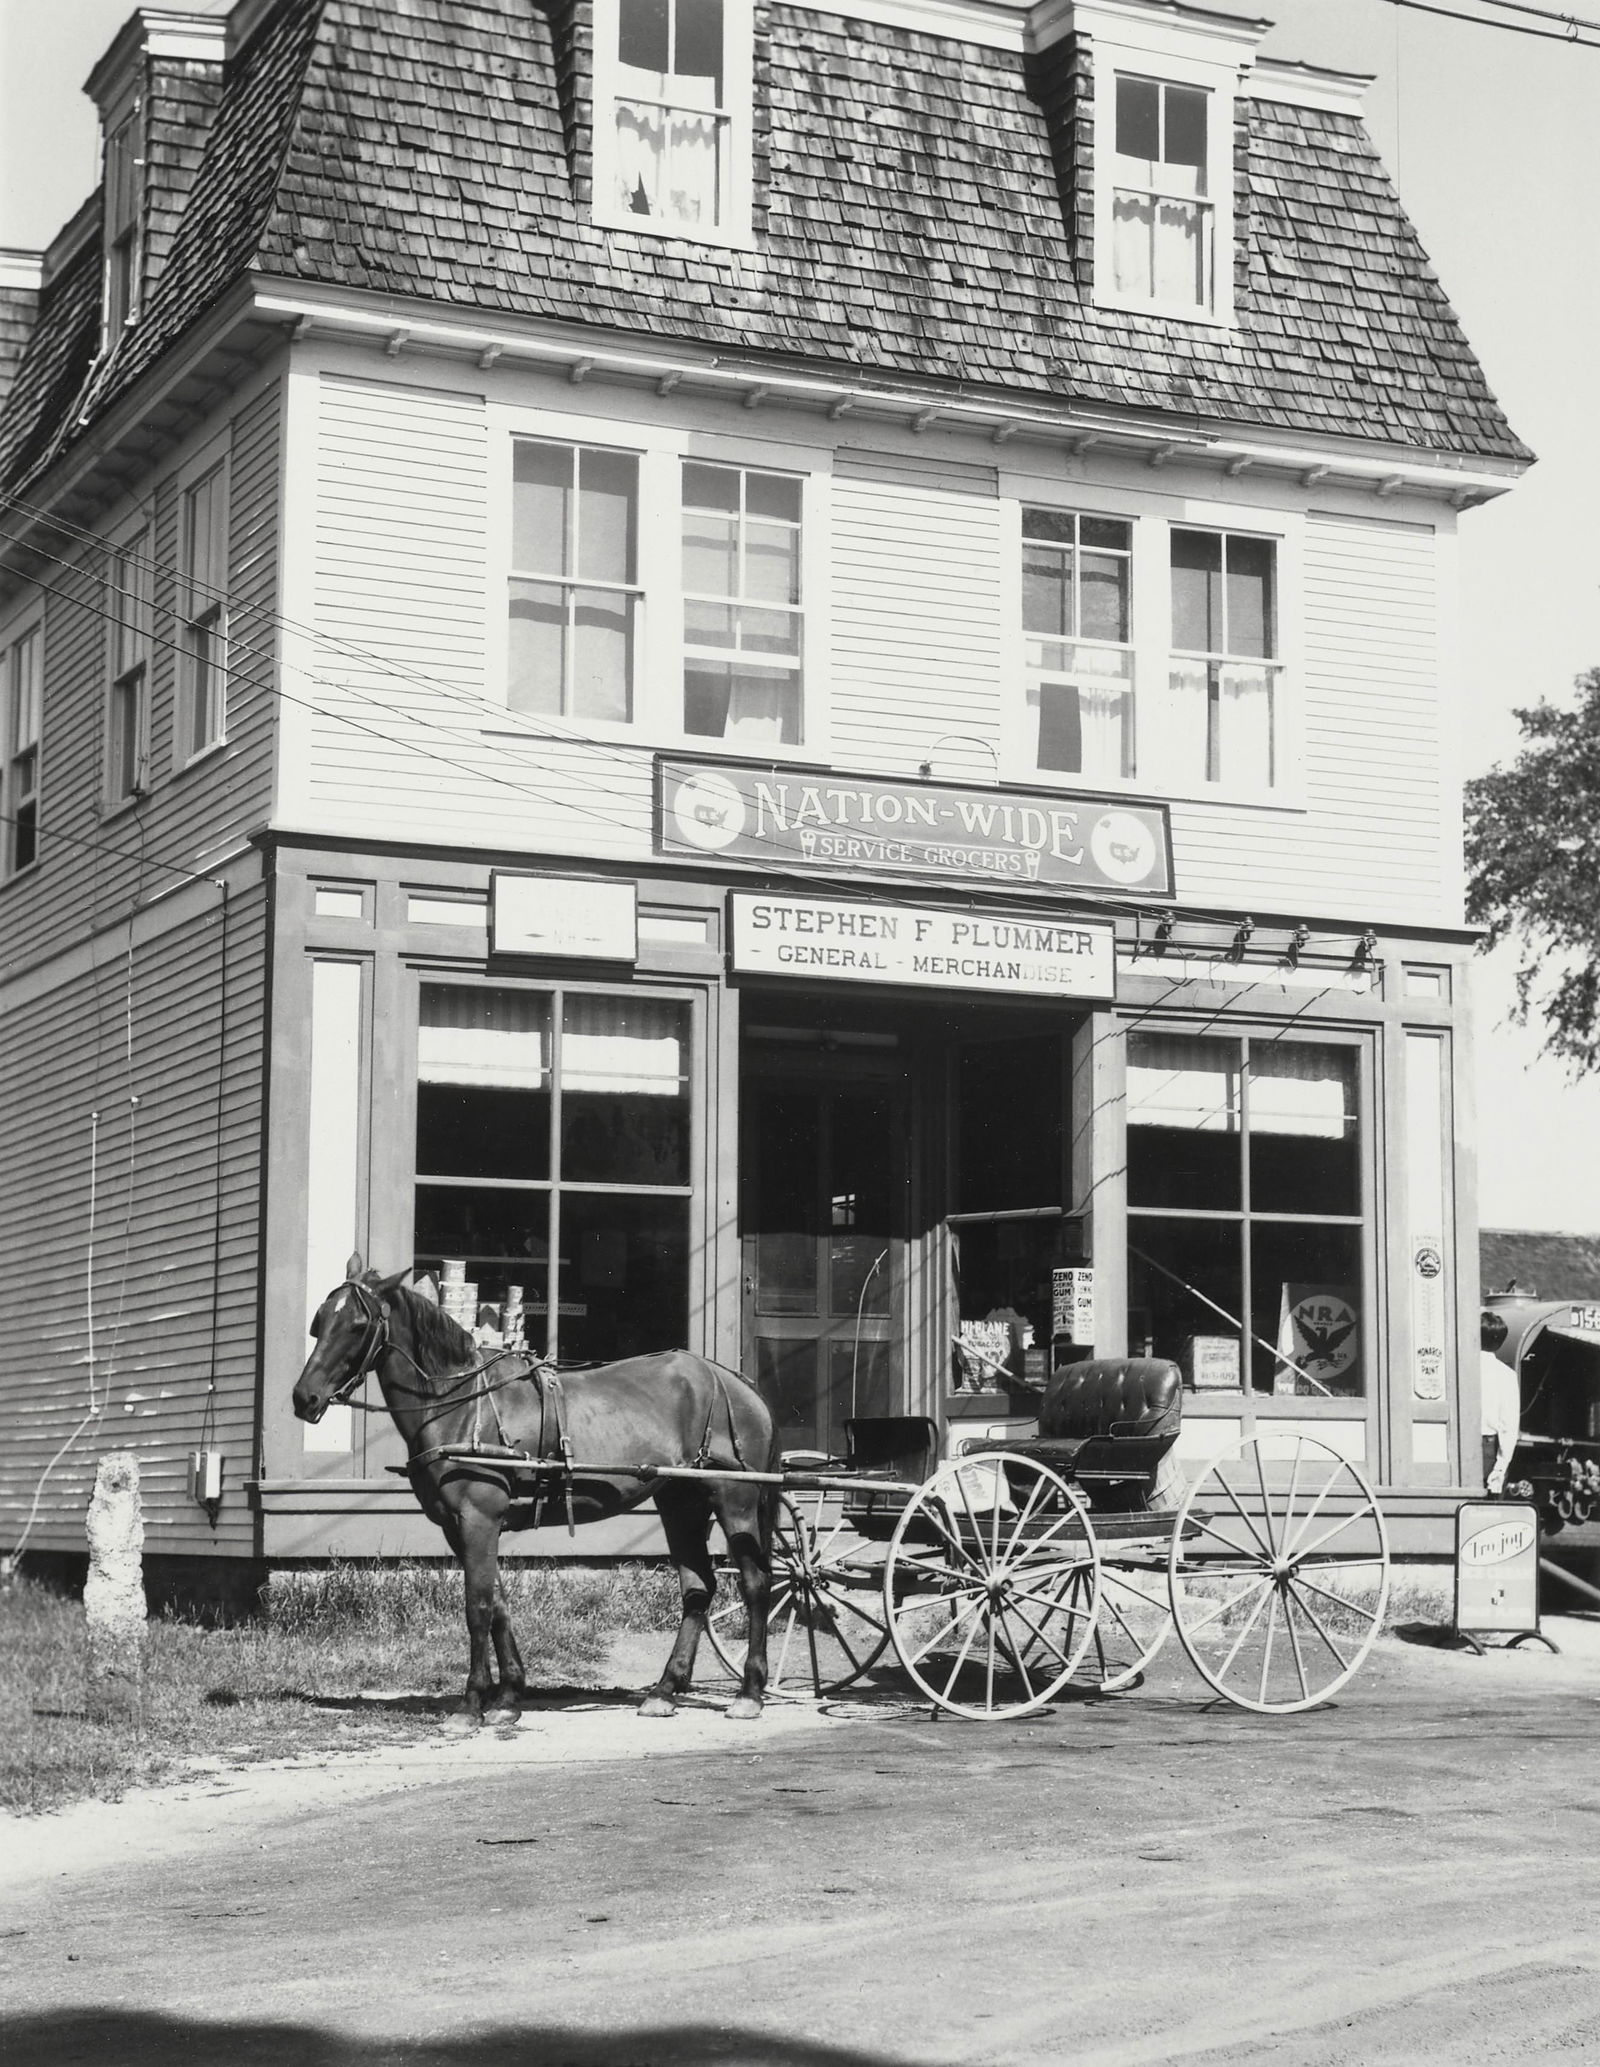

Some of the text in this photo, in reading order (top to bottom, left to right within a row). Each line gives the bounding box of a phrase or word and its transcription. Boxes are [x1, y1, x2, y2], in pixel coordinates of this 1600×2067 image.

[754, 781, 1084, 866] NATION-WIDE
[820, 838, 1022, 873] SERVICE GROCERS
[752, 905, 1094, 956] STEPHEN F PLUMMER
[778, 944, 1073, 984] GENERAL MERCHANDISE
[1053, 1271, 1073, 1282] ZENO
[1053, 1288, 1071, 1296] GUM
[1299, 1305, 1351, 1323] NRA
